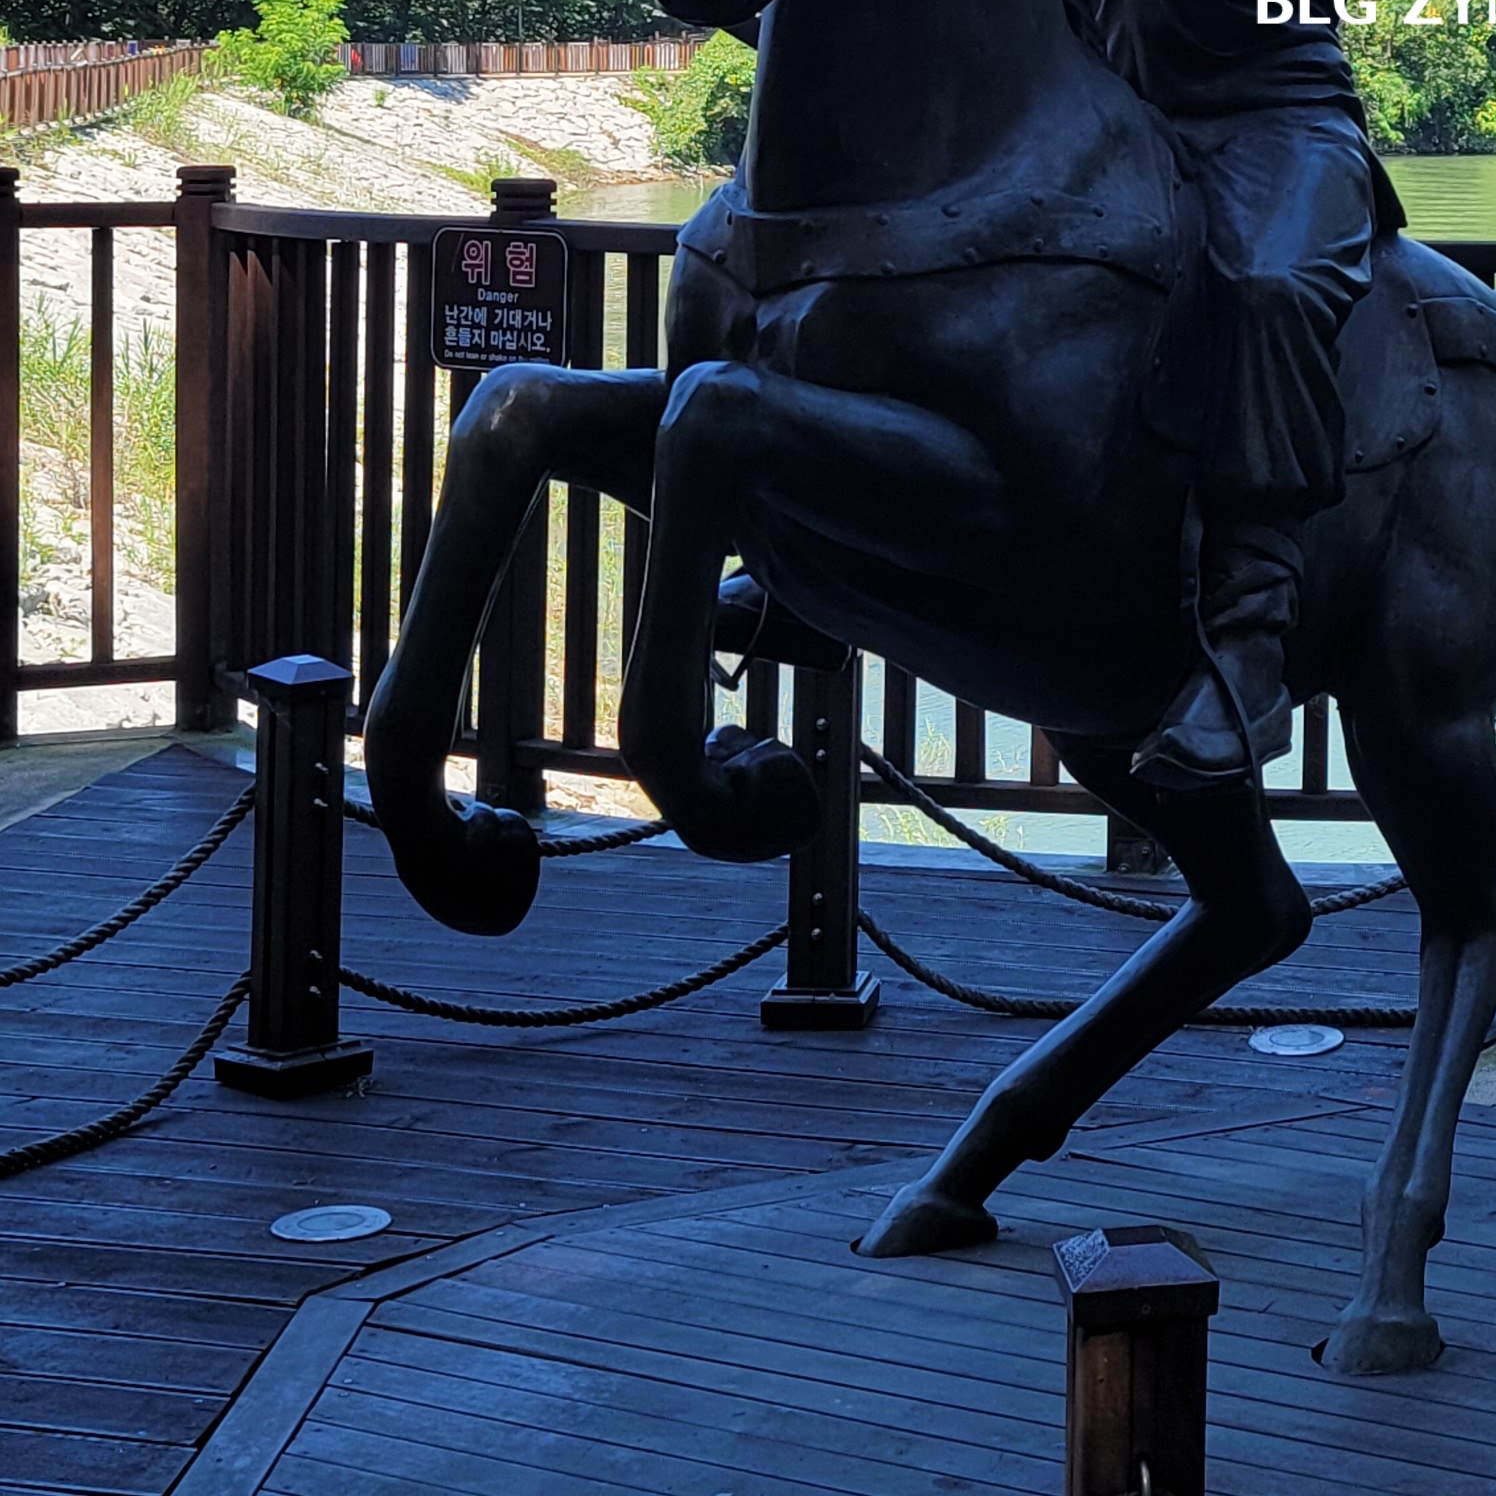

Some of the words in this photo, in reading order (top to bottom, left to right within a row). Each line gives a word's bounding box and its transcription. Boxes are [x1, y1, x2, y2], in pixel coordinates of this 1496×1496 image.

[478, 288, 519, 304] Danger
[445, 304, 487, 326] 난간에
[494, 308, 552, 331] 기대거나
[444, 326, 485, 349] 흔들지
[490, 329, 551, 353] 마십시오.
